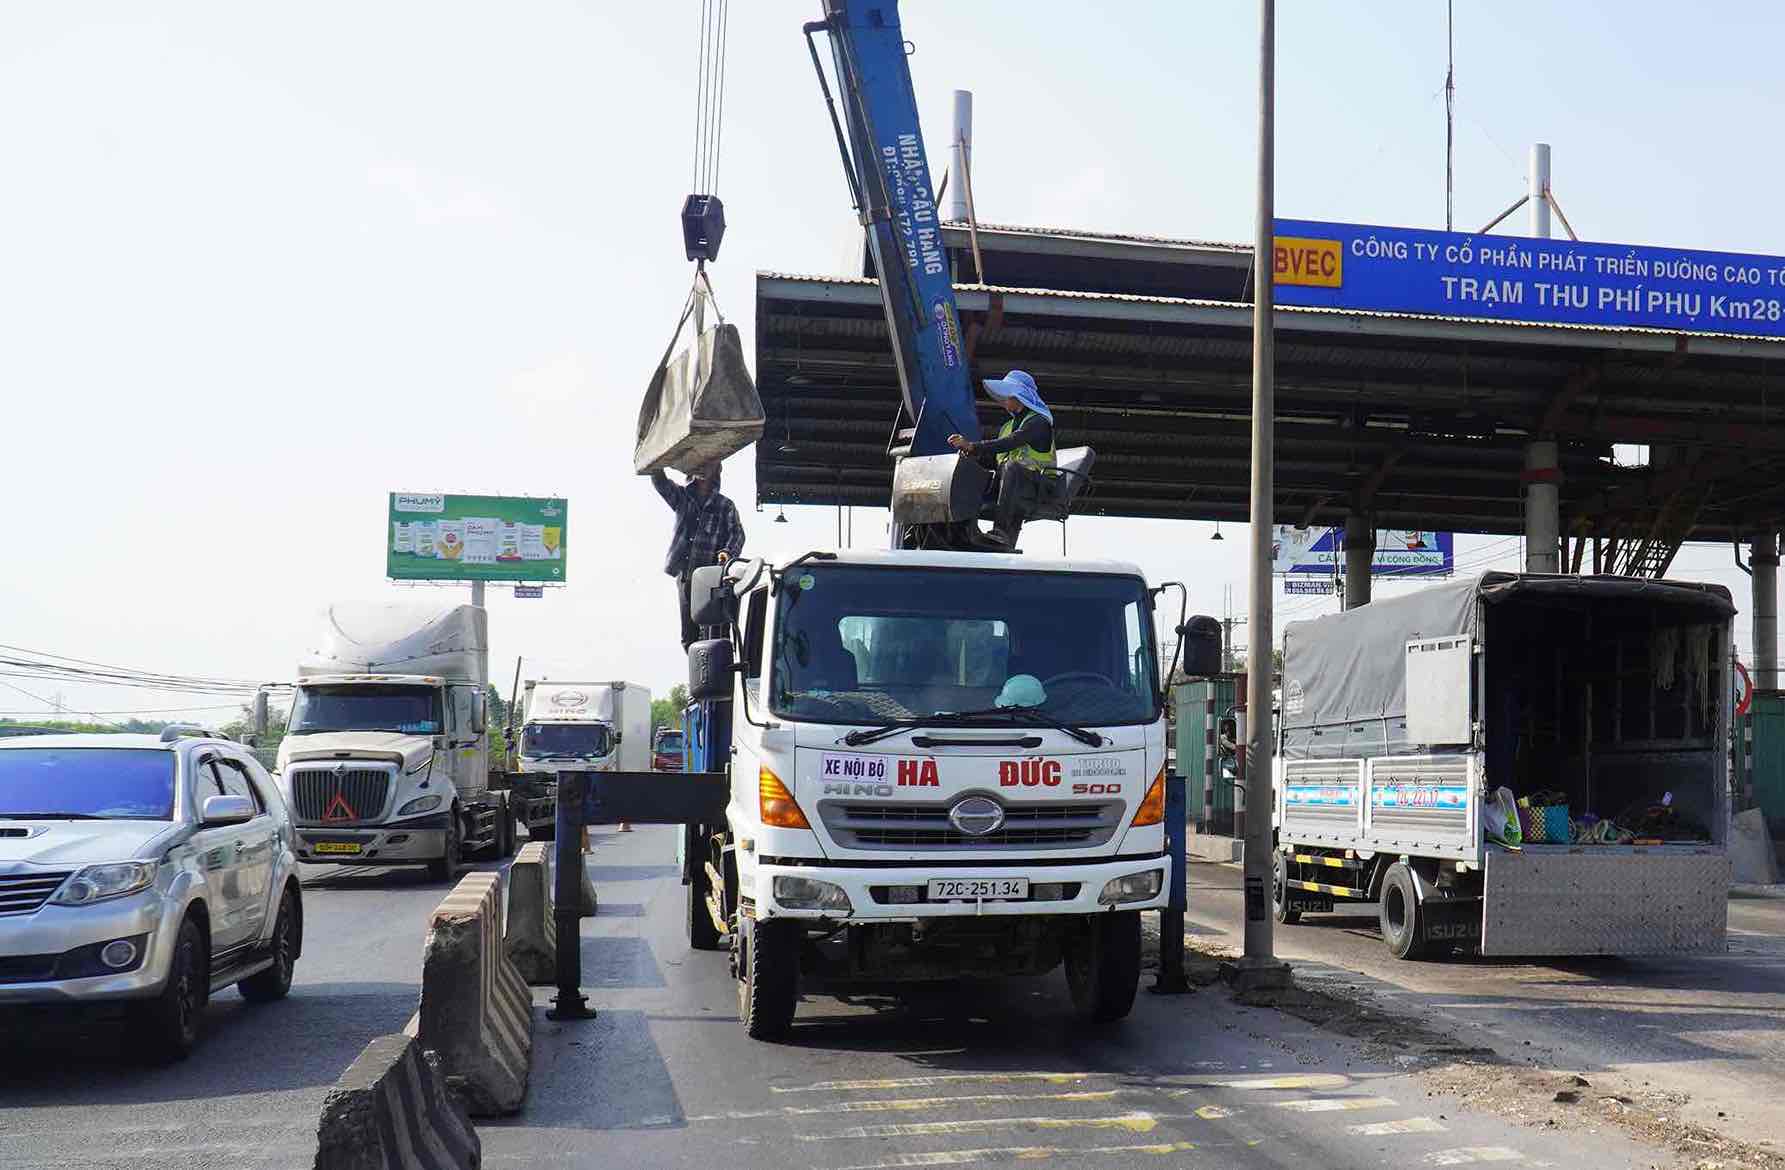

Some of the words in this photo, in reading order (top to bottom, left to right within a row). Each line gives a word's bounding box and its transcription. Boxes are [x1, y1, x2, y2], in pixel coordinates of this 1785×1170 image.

[1274, 247, 1336, 277] BVEC
[1352, 235, 1408, 260] CÔNG
[1414, 243, 1439, 261] TY
[1446, 236, 1473, 265] CỔ
[1480, 242, 1532, 268] PHẦN
[1539, 249, 1587, 273] PHÁT
[1594, 249, 1648, 277] TRIỂN
[1653, 257, 1717, 282] ĐƯỜNG
[1724, 266, 1761, 286] CAO
[1441, 276, 1523, 308] TRẠM
[1534, 282, 1589, 309] THU
[1599, 284, 1640, 312] PHÍ
[1648, 291, 1700, 322] PHỤ
[825, 760, 841, 775] XE
[843, 758, 865, 779] NỘI
[868, 759, 885, 781] BỘ
[897, 756, 940, 787] HÀ
[998, 757, 1061, 786] ĐỨC
[823, 784, 894, 797] HINO
[1072, 783, 1121, 794] 500
[937, 881, 1020, 896] 72C-251.34
[1288, 900, 1333, 912] ISUZU
[1427, 922, 1479, 938] ISUZU
